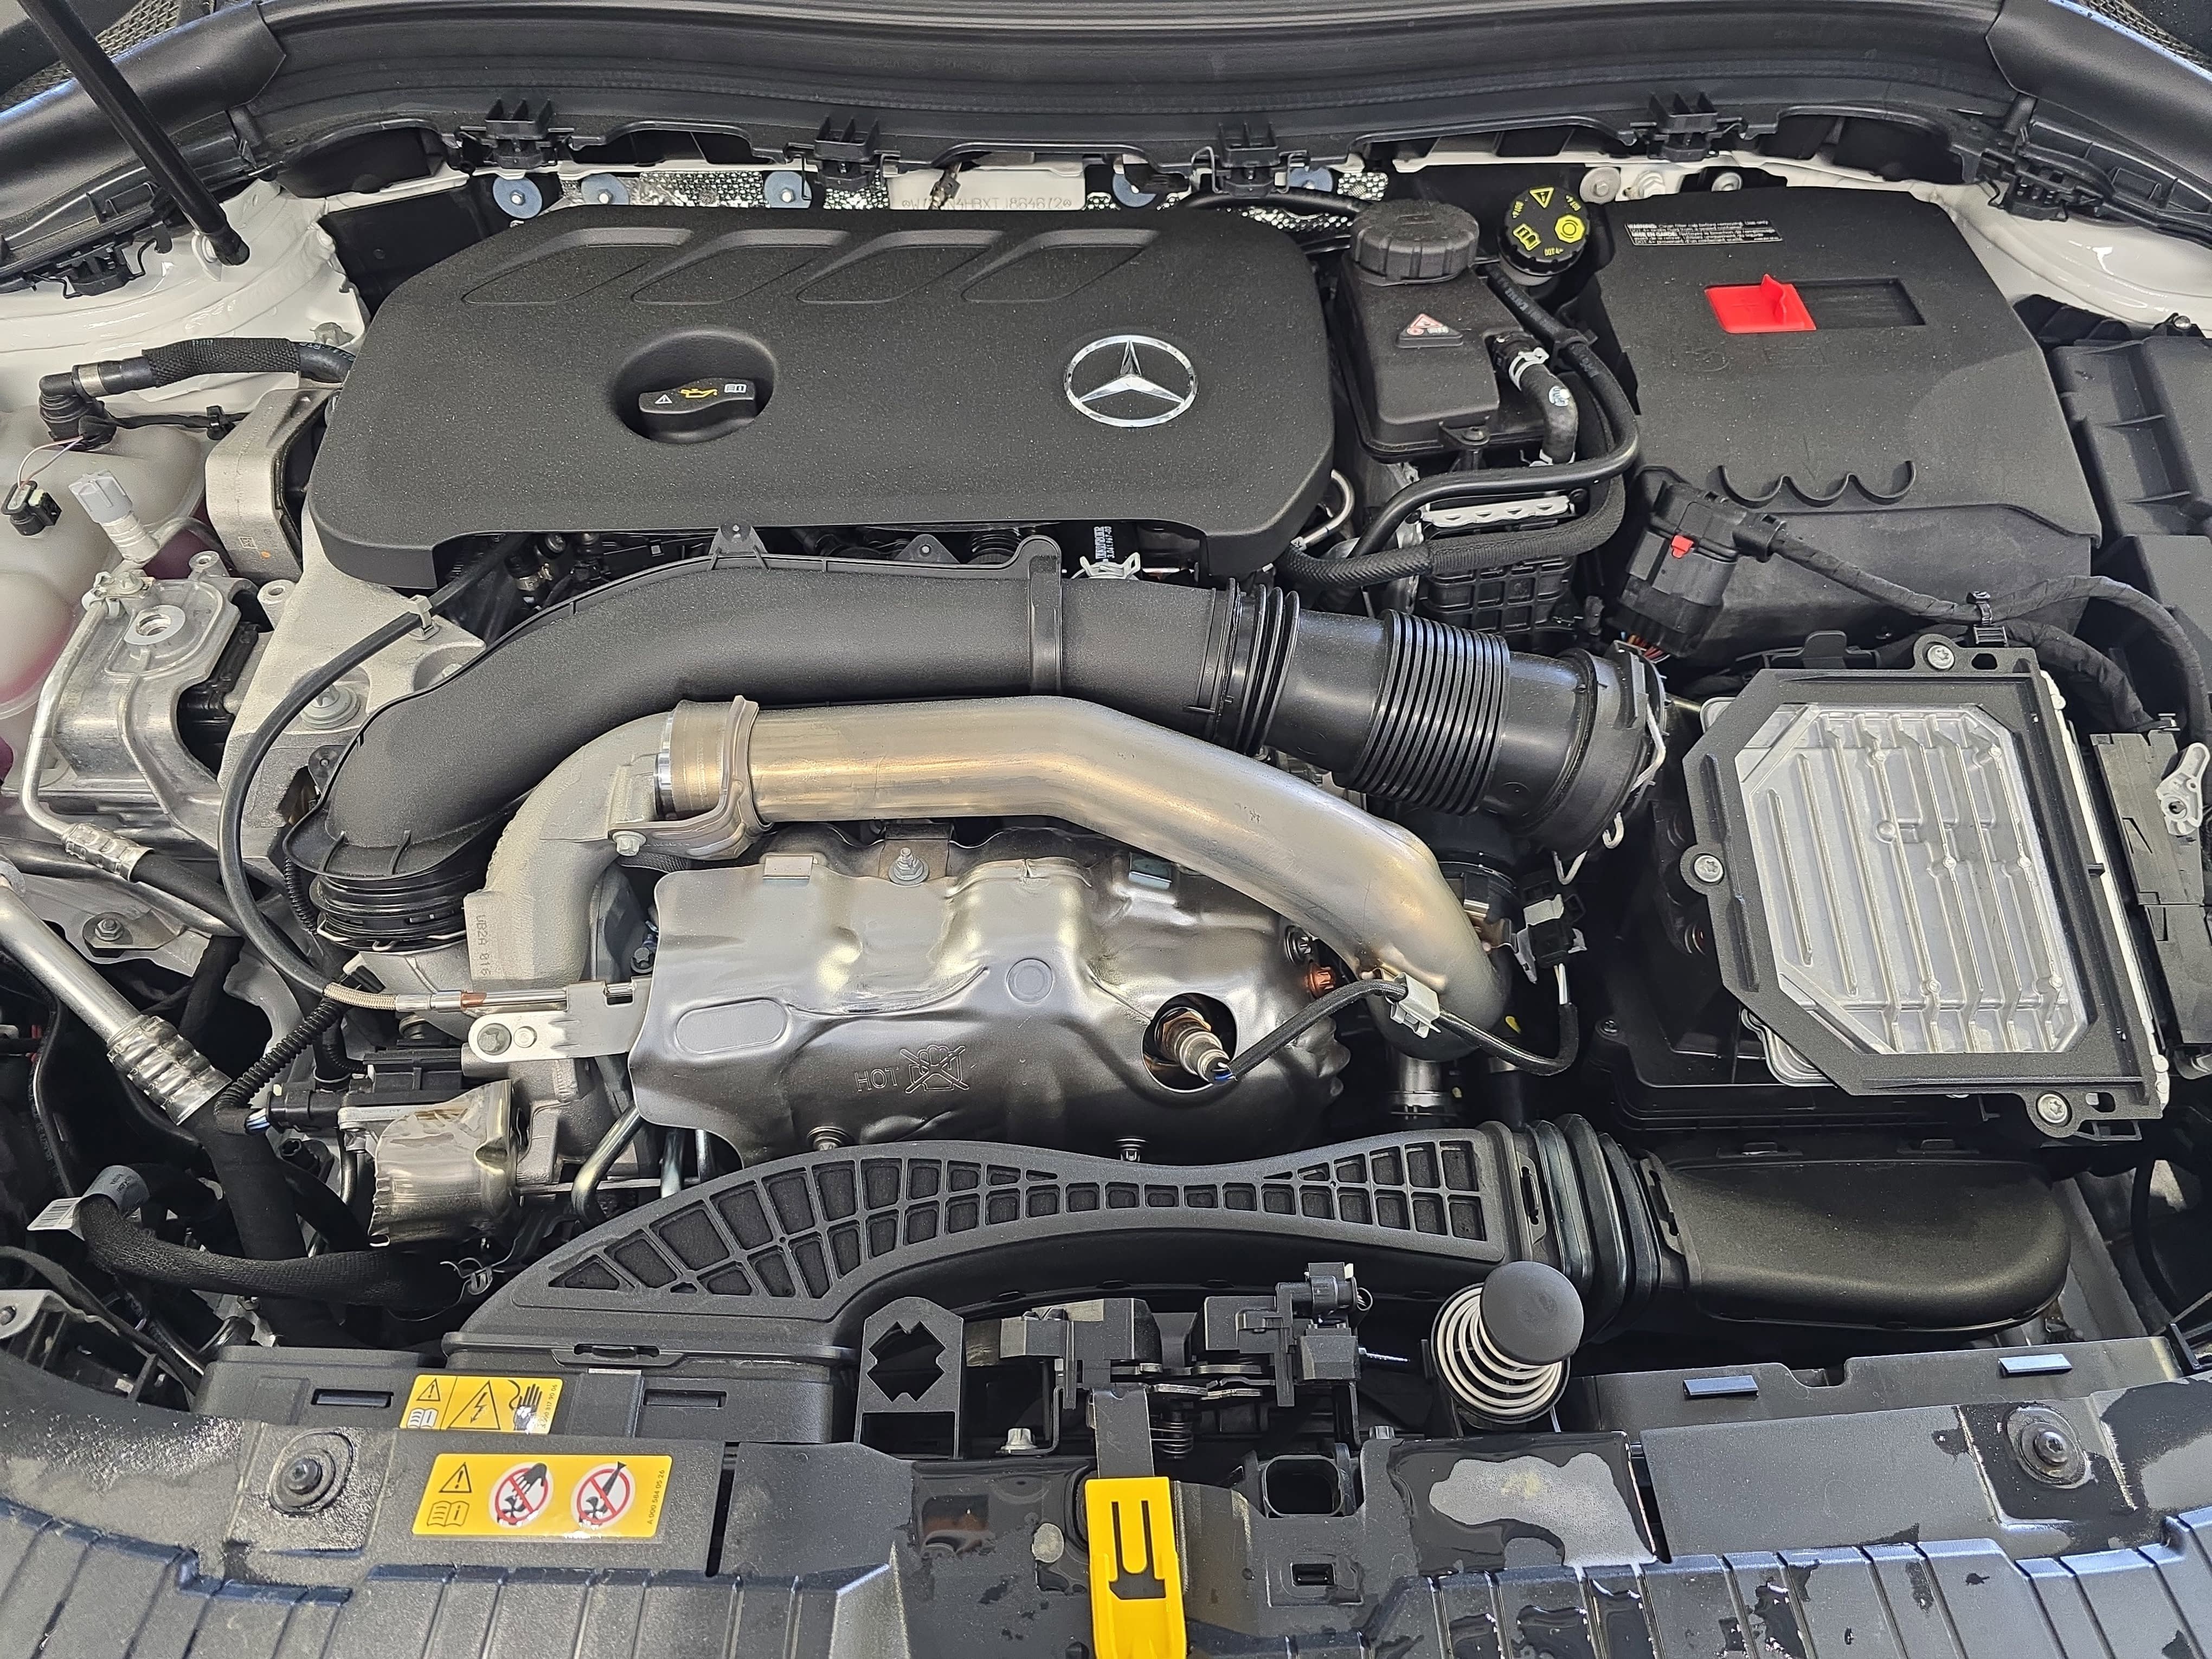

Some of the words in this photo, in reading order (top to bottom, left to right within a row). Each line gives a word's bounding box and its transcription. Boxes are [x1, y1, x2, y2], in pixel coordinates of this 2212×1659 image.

[854, 1066, 898, 1092] HOT
[648, 1504, 657, 1518] 000
[655, 1480, 663, 1489] 05
[659, 1469, 665, 1478] 26
